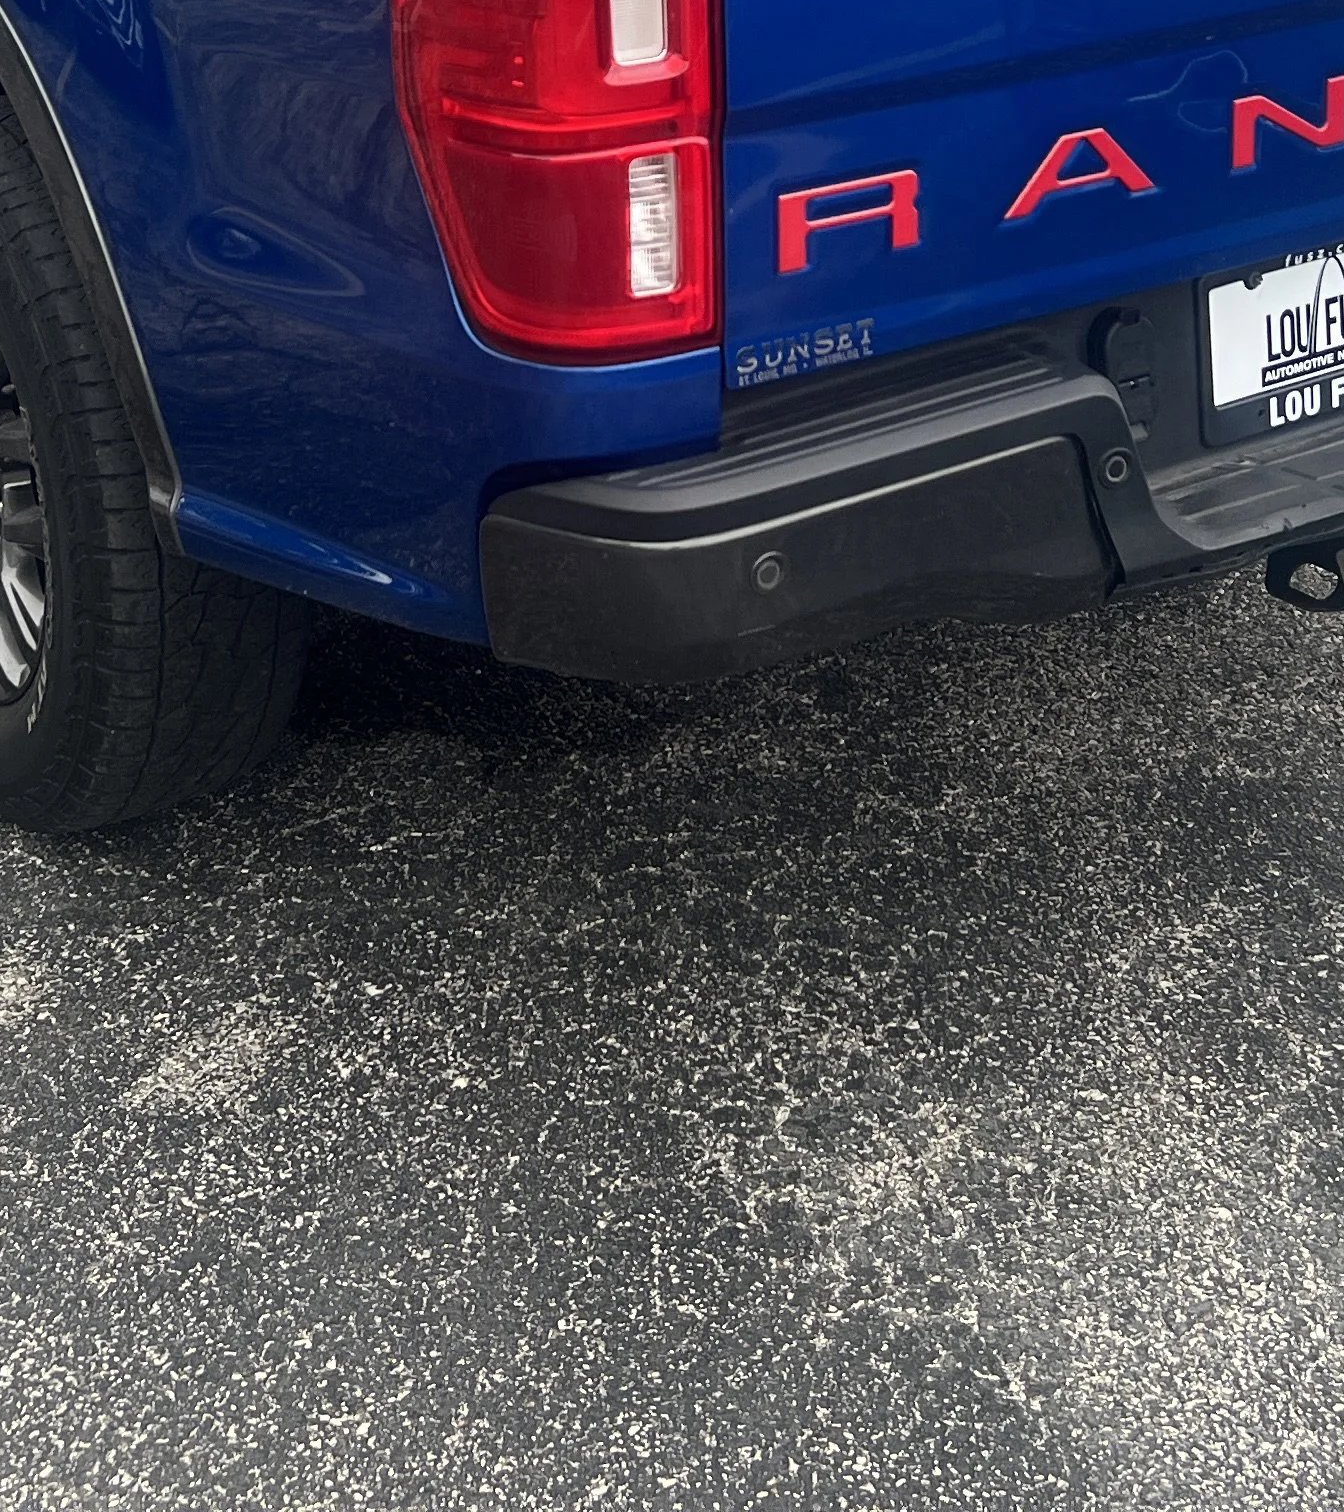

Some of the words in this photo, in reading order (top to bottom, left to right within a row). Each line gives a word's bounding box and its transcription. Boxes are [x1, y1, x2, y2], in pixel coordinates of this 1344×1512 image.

[736, 317, 875, 374] SUNSET
[1266, 303, 1311, 363] LOU
[1263, 353, 1335, 384] AUTOMOTIVE
[1269, 382, 1322, 428] LOU
